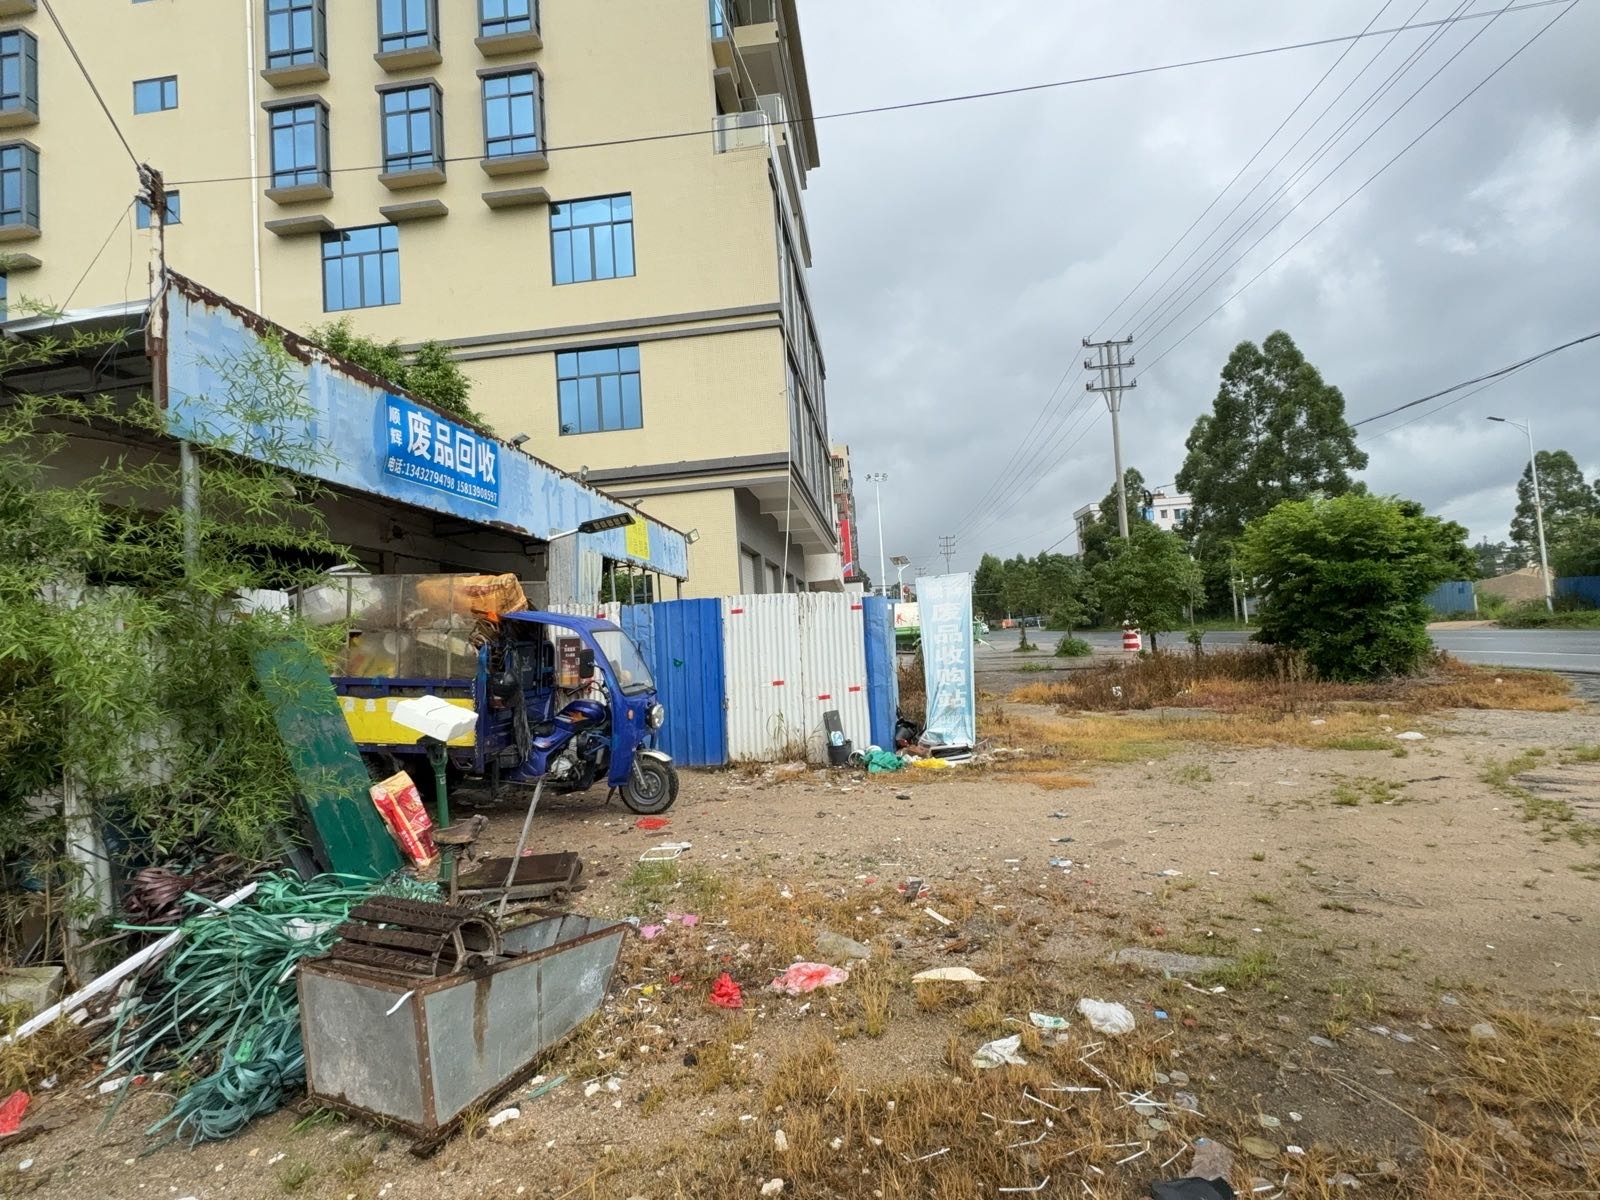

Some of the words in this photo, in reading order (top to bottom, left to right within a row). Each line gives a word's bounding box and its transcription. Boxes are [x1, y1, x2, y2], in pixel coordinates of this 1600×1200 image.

[407, 410, 496, 485] 废品回收
[932, 602, 966, 709] 废品收购站
